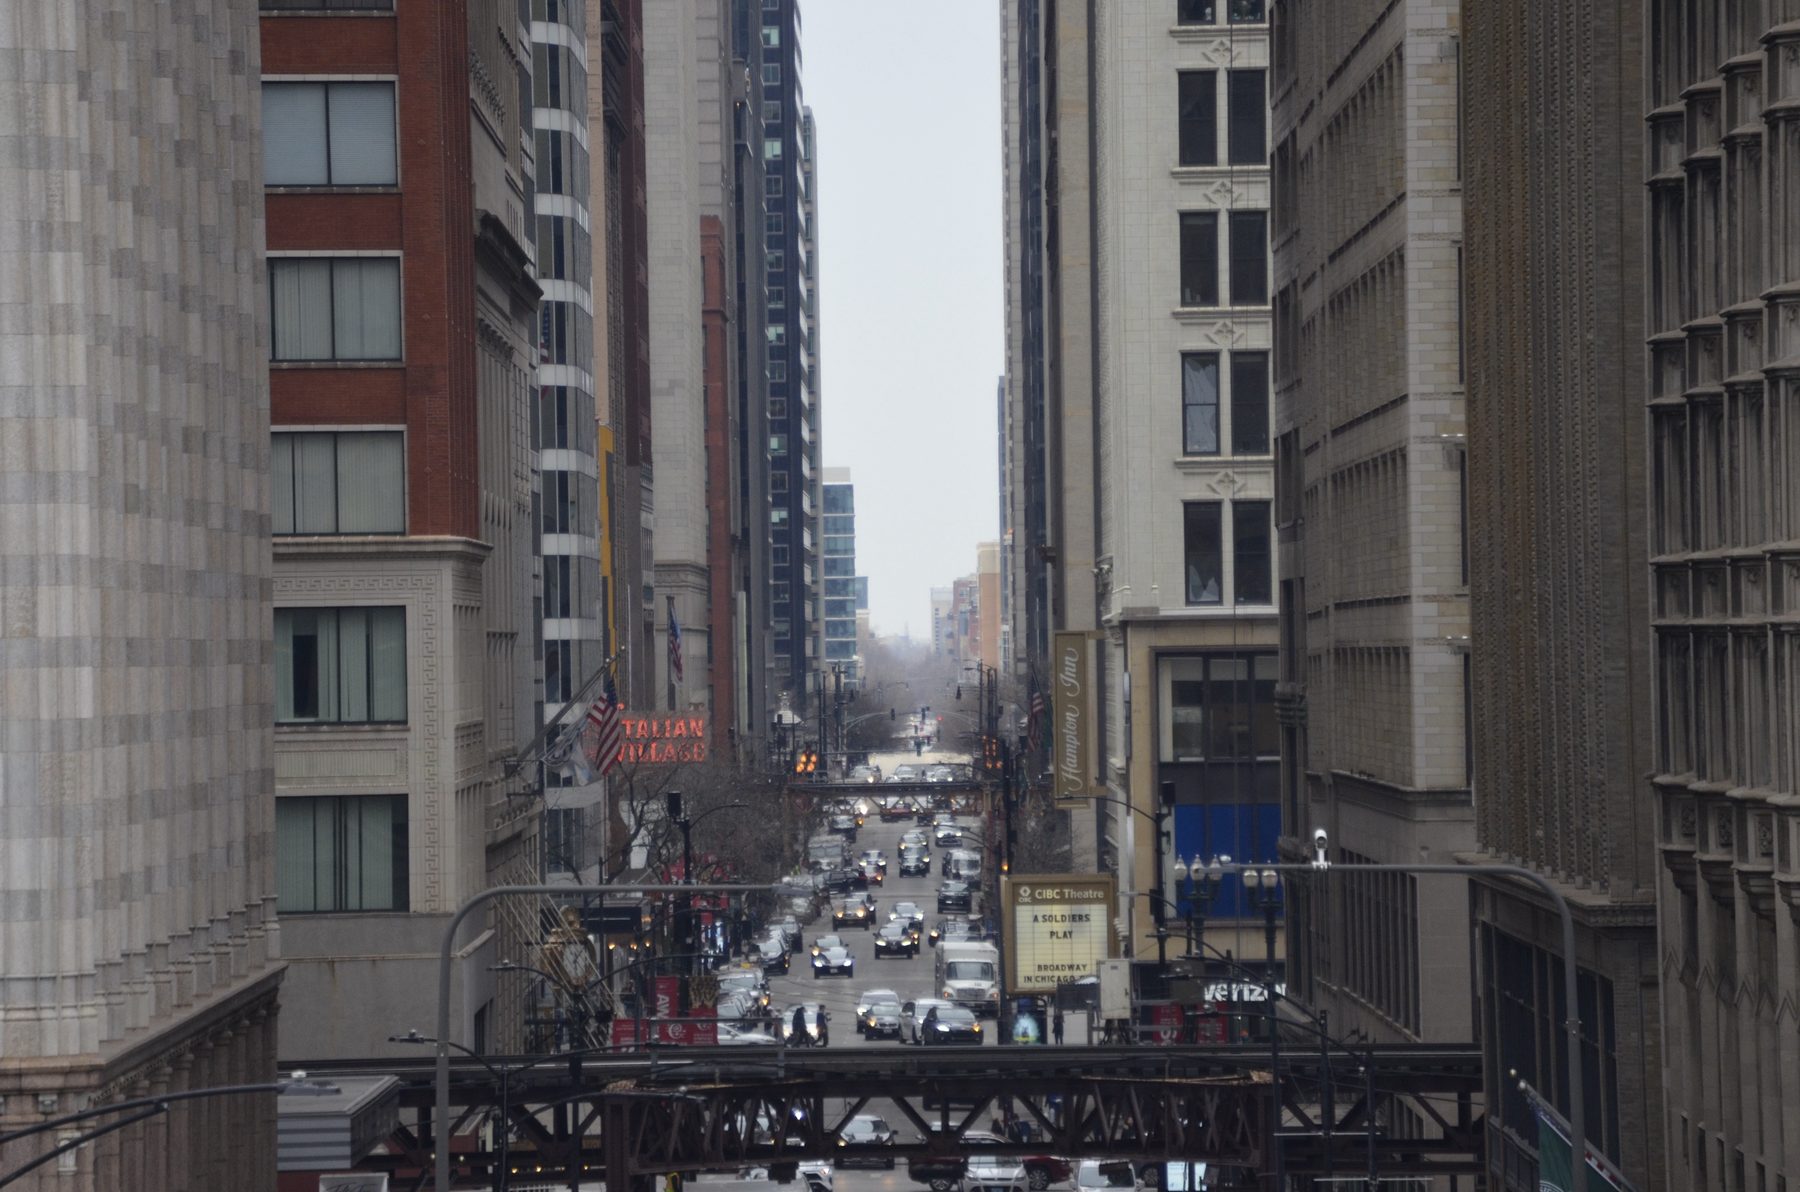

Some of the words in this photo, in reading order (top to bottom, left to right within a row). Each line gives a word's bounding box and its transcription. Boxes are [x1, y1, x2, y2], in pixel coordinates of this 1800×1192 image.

[1059, 647, 1081, 697] Inn
[621, 717, 705, 738] TALIAN
[1060, 704, 1083, 792] Hampton
[1035, 889, 1060, 899] CIBC
[1062, 888, 1104, 899] Theatre
[1033, 914, 1039, 923] A
[1041, 913, 1091, 923] SOLDIERS
[1049, 930, 1074, 940] PLAY
[1037, 964, 1088, 972] BROADWAY
[1024, 975, 1033, 983] IN
